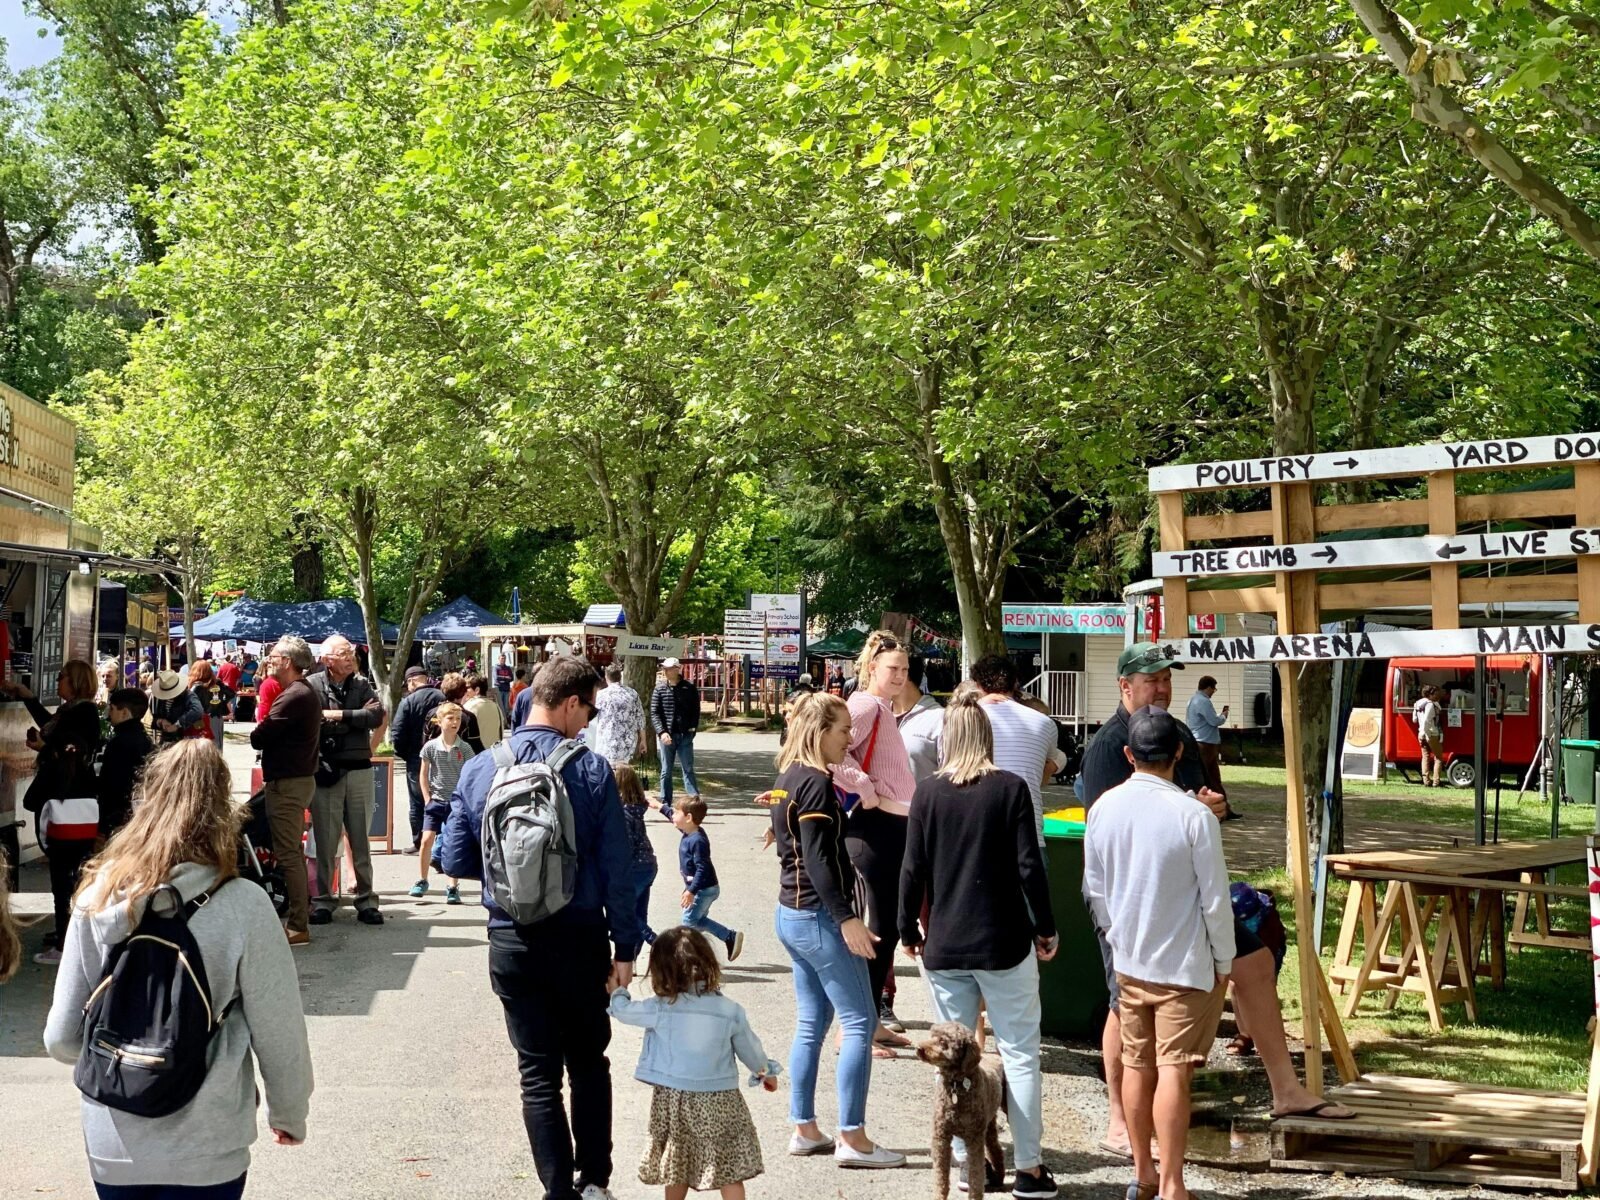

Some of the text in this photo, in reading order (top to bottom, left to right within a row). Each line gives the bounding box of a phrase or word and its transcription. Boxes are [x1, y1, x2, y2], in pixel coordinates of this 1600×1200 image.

[1445, 437, 1600, 468] YARD DO
[1197, 455, 1315, 487] POULTRY
[1480, 530, 1549, 558] LIVE
[1170, 546, 1298, 573] TREE CLIMB
[629, 642, 665, 651] Lions Bar
[1189, 632, 1376, 662] MAIN ARENA
[1477, 625, 1567, 654] MAIN
